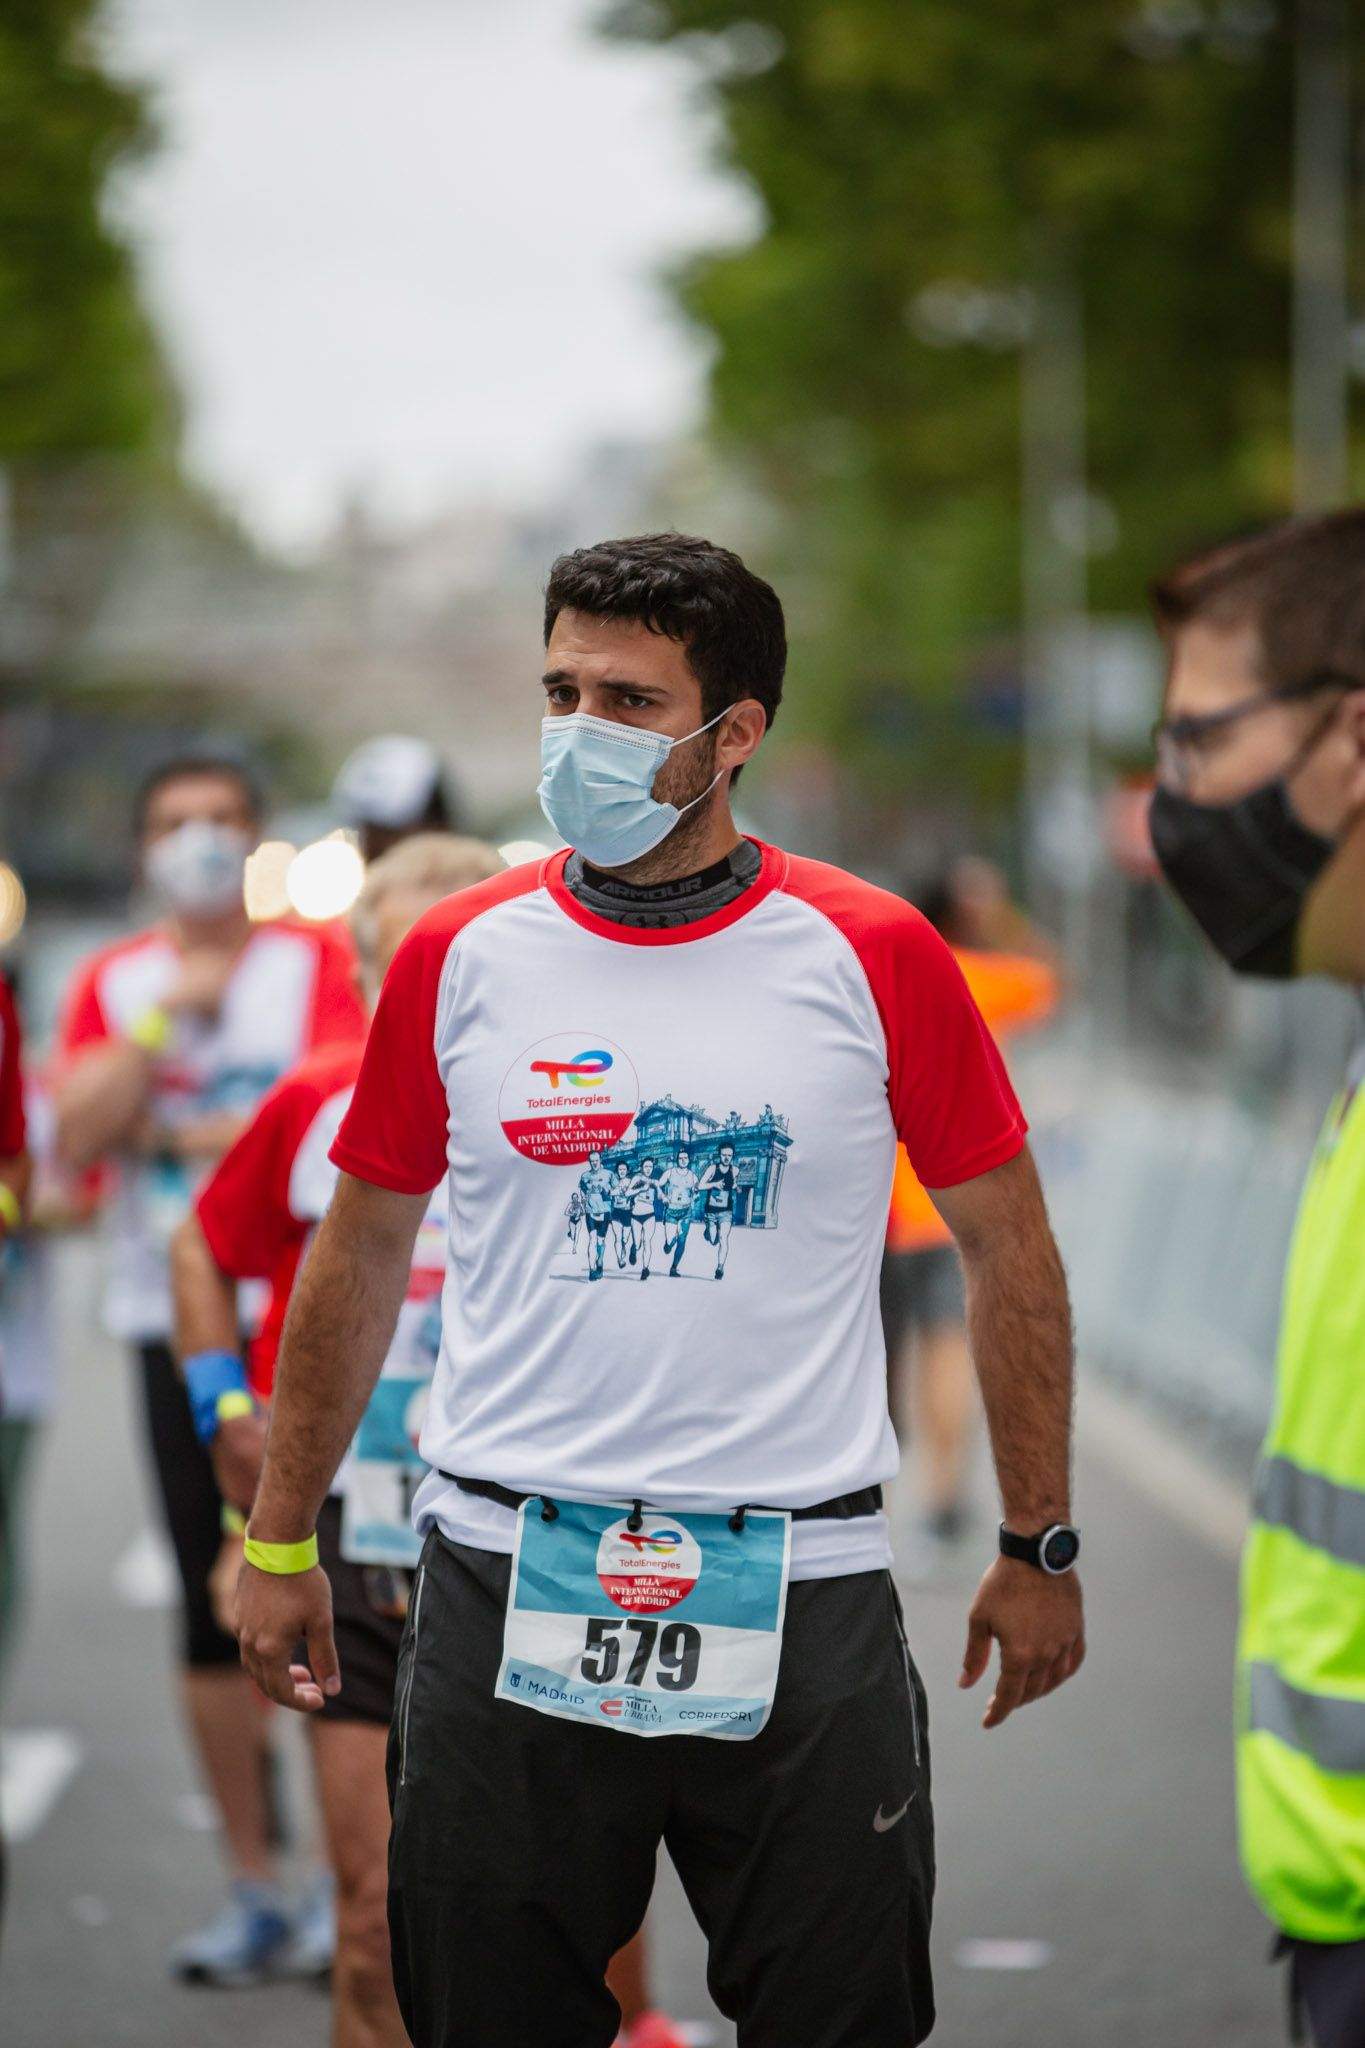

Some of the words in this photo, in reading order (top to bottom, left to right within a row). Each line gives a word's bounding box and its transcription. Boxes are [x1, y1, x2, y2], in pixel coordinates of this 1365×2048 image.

[598, 876, 703, 899] ARMOUR
[526, 1094, 611, 1108] TotalEnergies
[545, 1118, 584, 1131] MILLA
[532, 1145, 549, 1156] DE
[552, 1141, 601, 1153] MADRID
[618, 1559, 681, 1570] TotalEnergies
[633, 1578, 660, 1587] MILLA
[633, 1596, 670, 1607] MADRID
[580, 1617, 702, 1692] 579
[527, 1680, 585, 1705] MADRID
